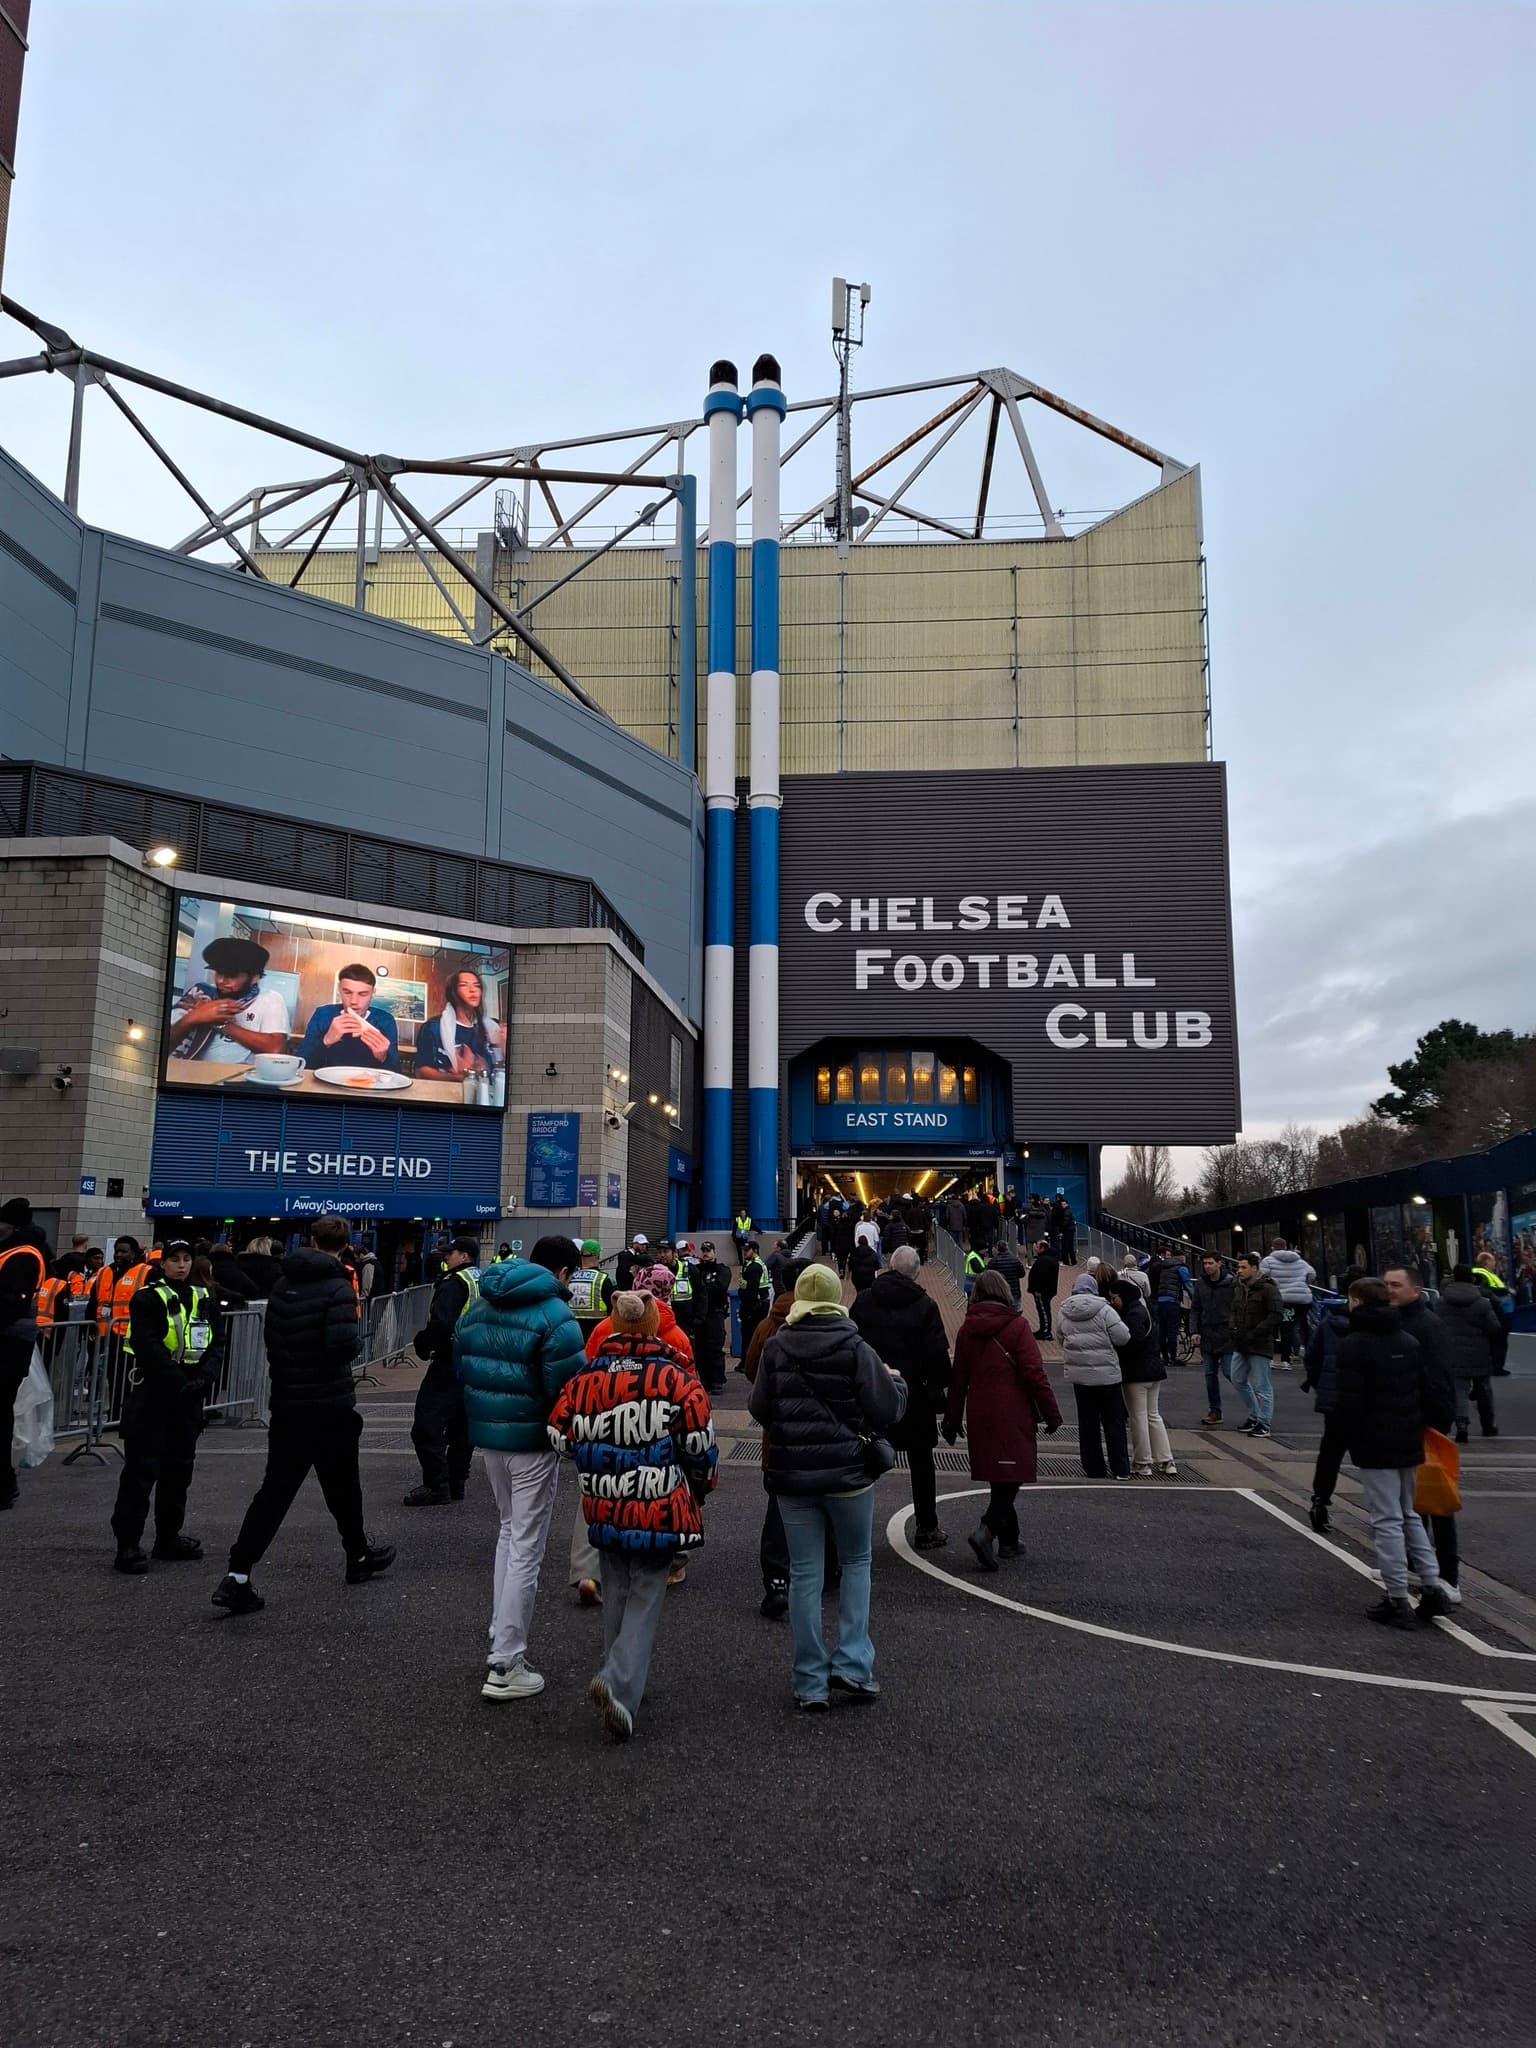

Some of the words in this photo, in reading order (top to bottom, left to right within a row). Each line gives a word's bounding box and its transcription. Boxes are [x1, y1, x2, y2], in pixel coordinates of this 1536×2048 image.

[804, 892, 1072, 933] CHELSEA
[855, 949, 1156, 991] FOOTBALL
[1045, 1003, 1213, 1049] CLUB
[532, 1126, 558, 1134] BRIDGE
[846, 1112, 888, 1127] EAST
[893, 1112, 948, 1127] STAND
[968, 1149, 985, 1157] Upper
[244, 1150, 298, 1173] THE
[307, 1153, 376, 1176] SHED
[382, 1156, 432, 1178] END
[82, 1181, 95, 1190] 4SE
[153, 1199, 180, 1208] Lower
[292, 1200, 323, 1213] Away
[326, 1200, 385, 1213] Supporters
[475, 1204, 496, 1214] Upper
[575, 1370, 639, 1415] TRUE
[609, 1399, 671, 1446] TRUE
[592, 1470, 638, 1499] LOVE
